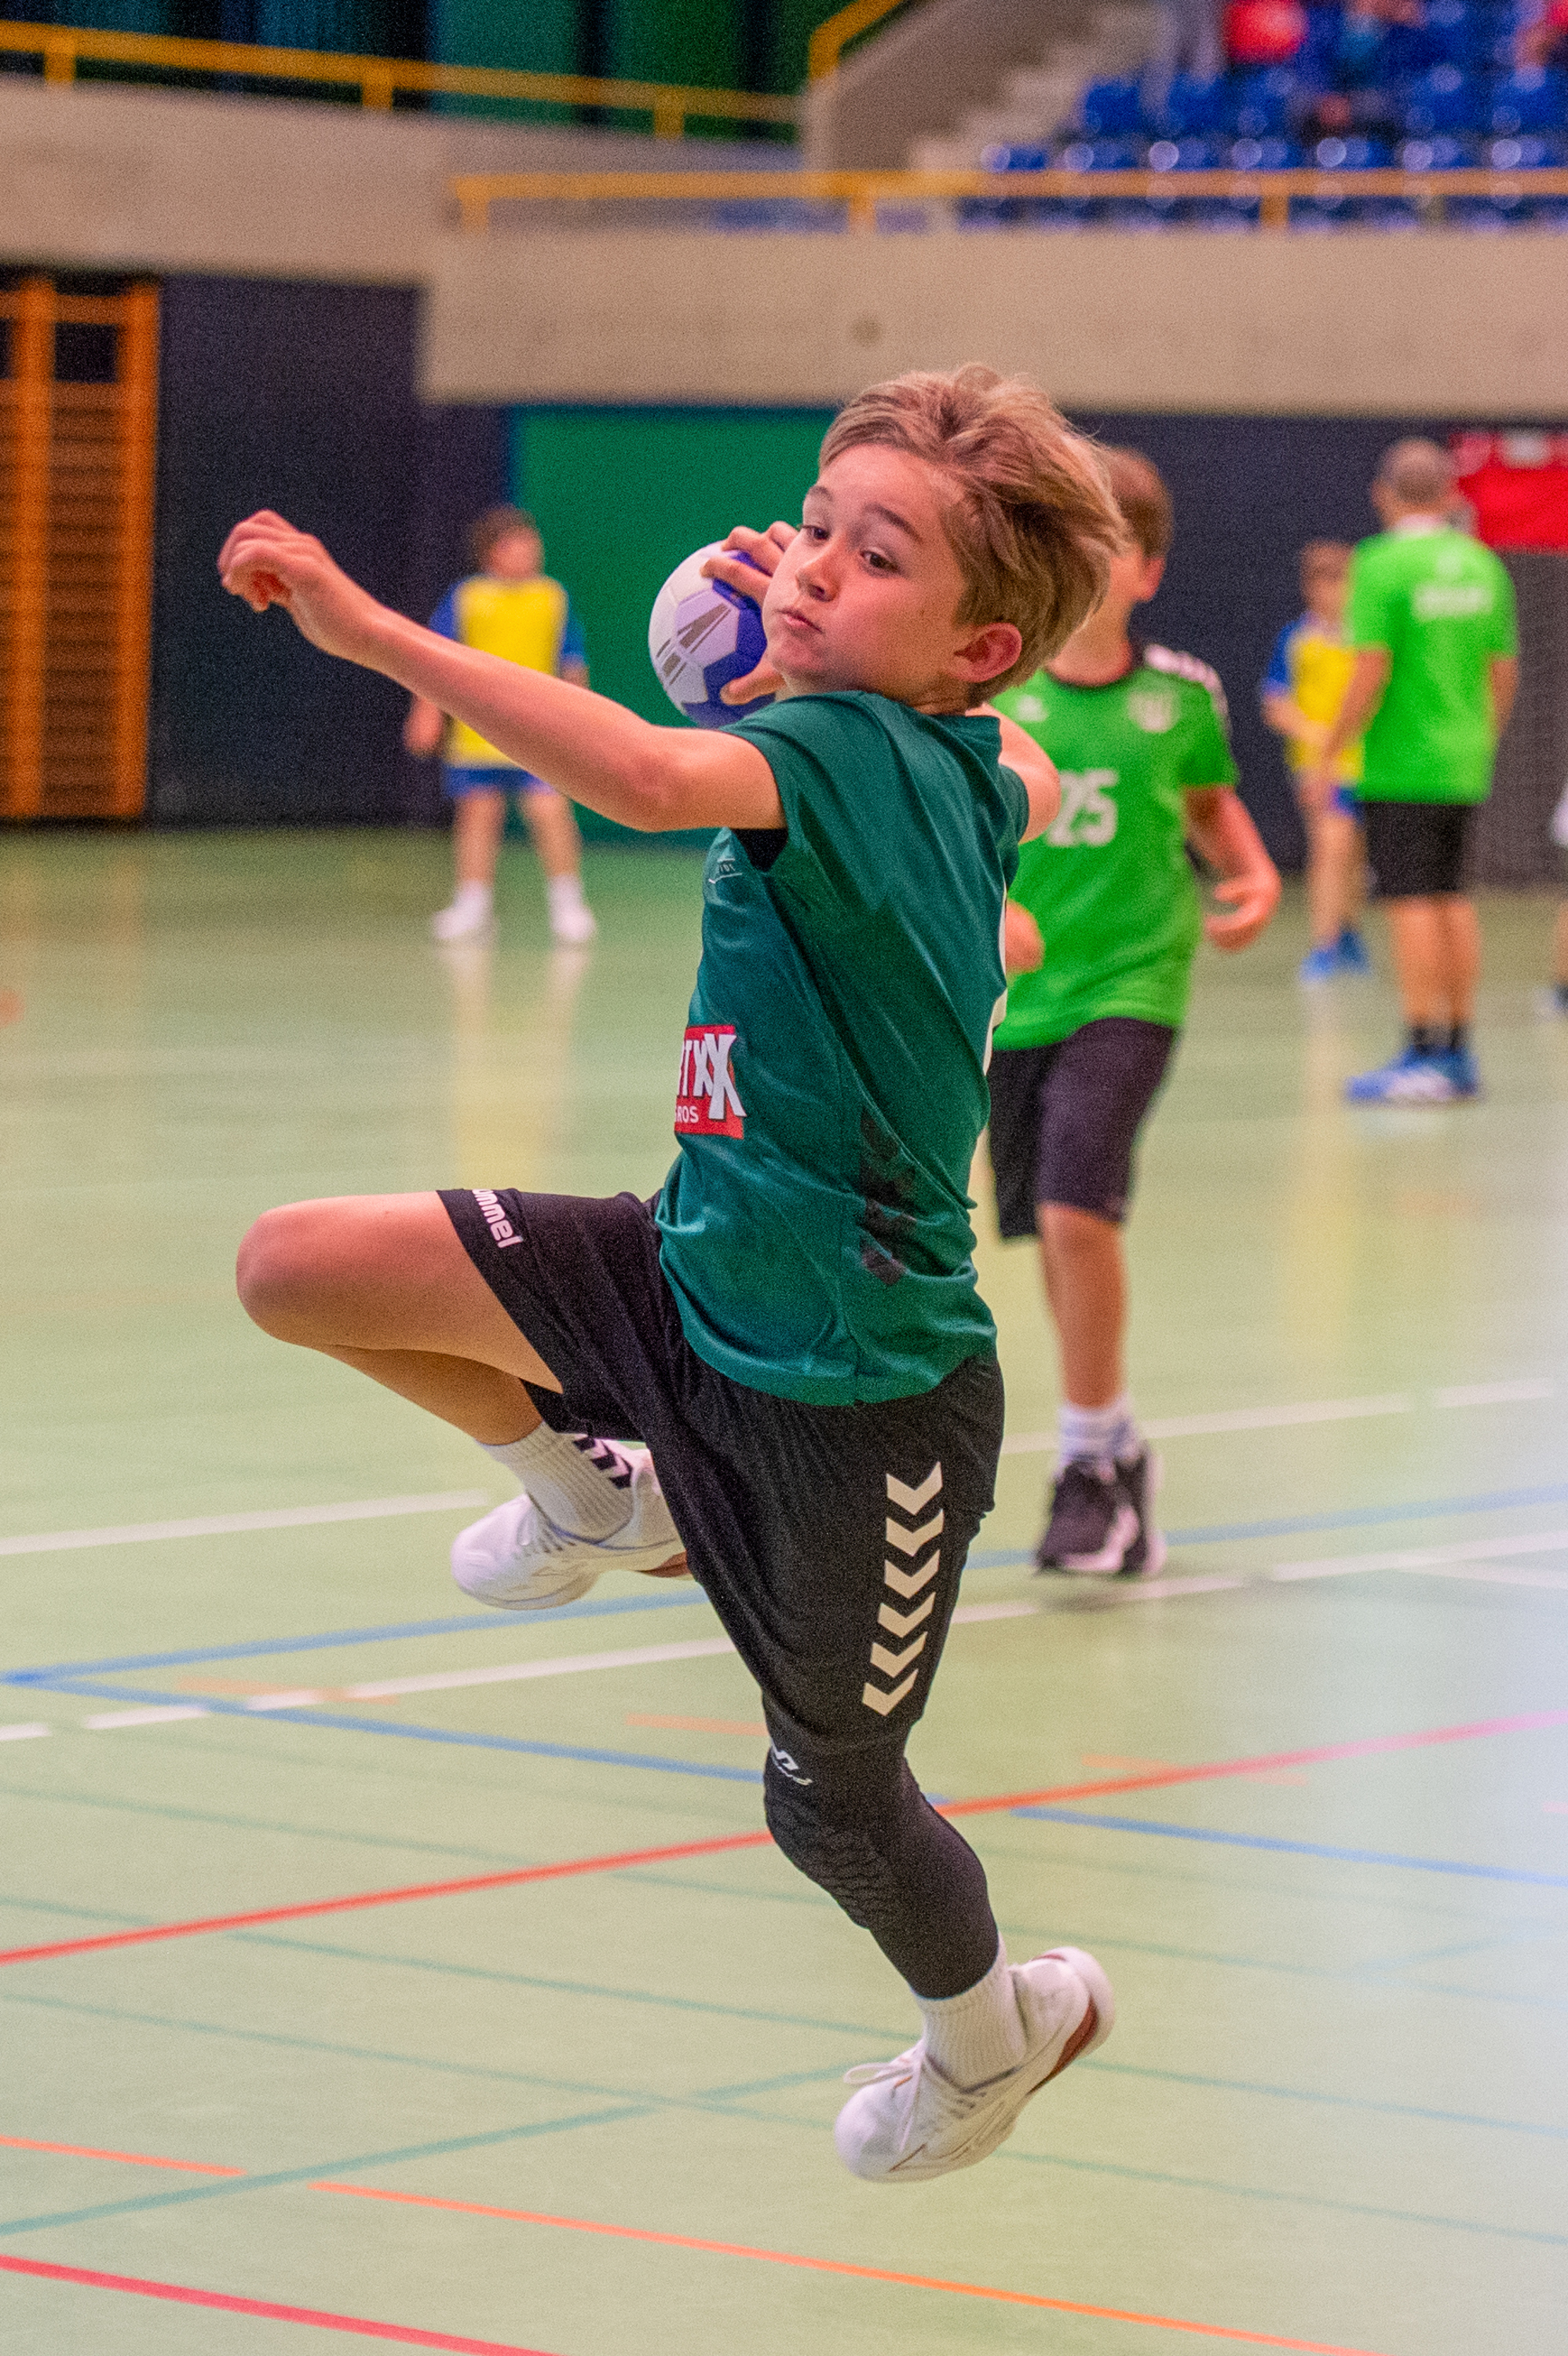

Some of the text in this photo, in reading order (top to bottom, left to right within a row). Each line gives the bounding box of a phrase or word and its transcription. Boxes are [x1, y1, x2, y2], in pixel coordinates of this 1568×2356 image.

[1046, 768, 1119, 847] 25
[675, 1105, 700, 1124] ROS
[677, 1033, 747, 1121] TXX
